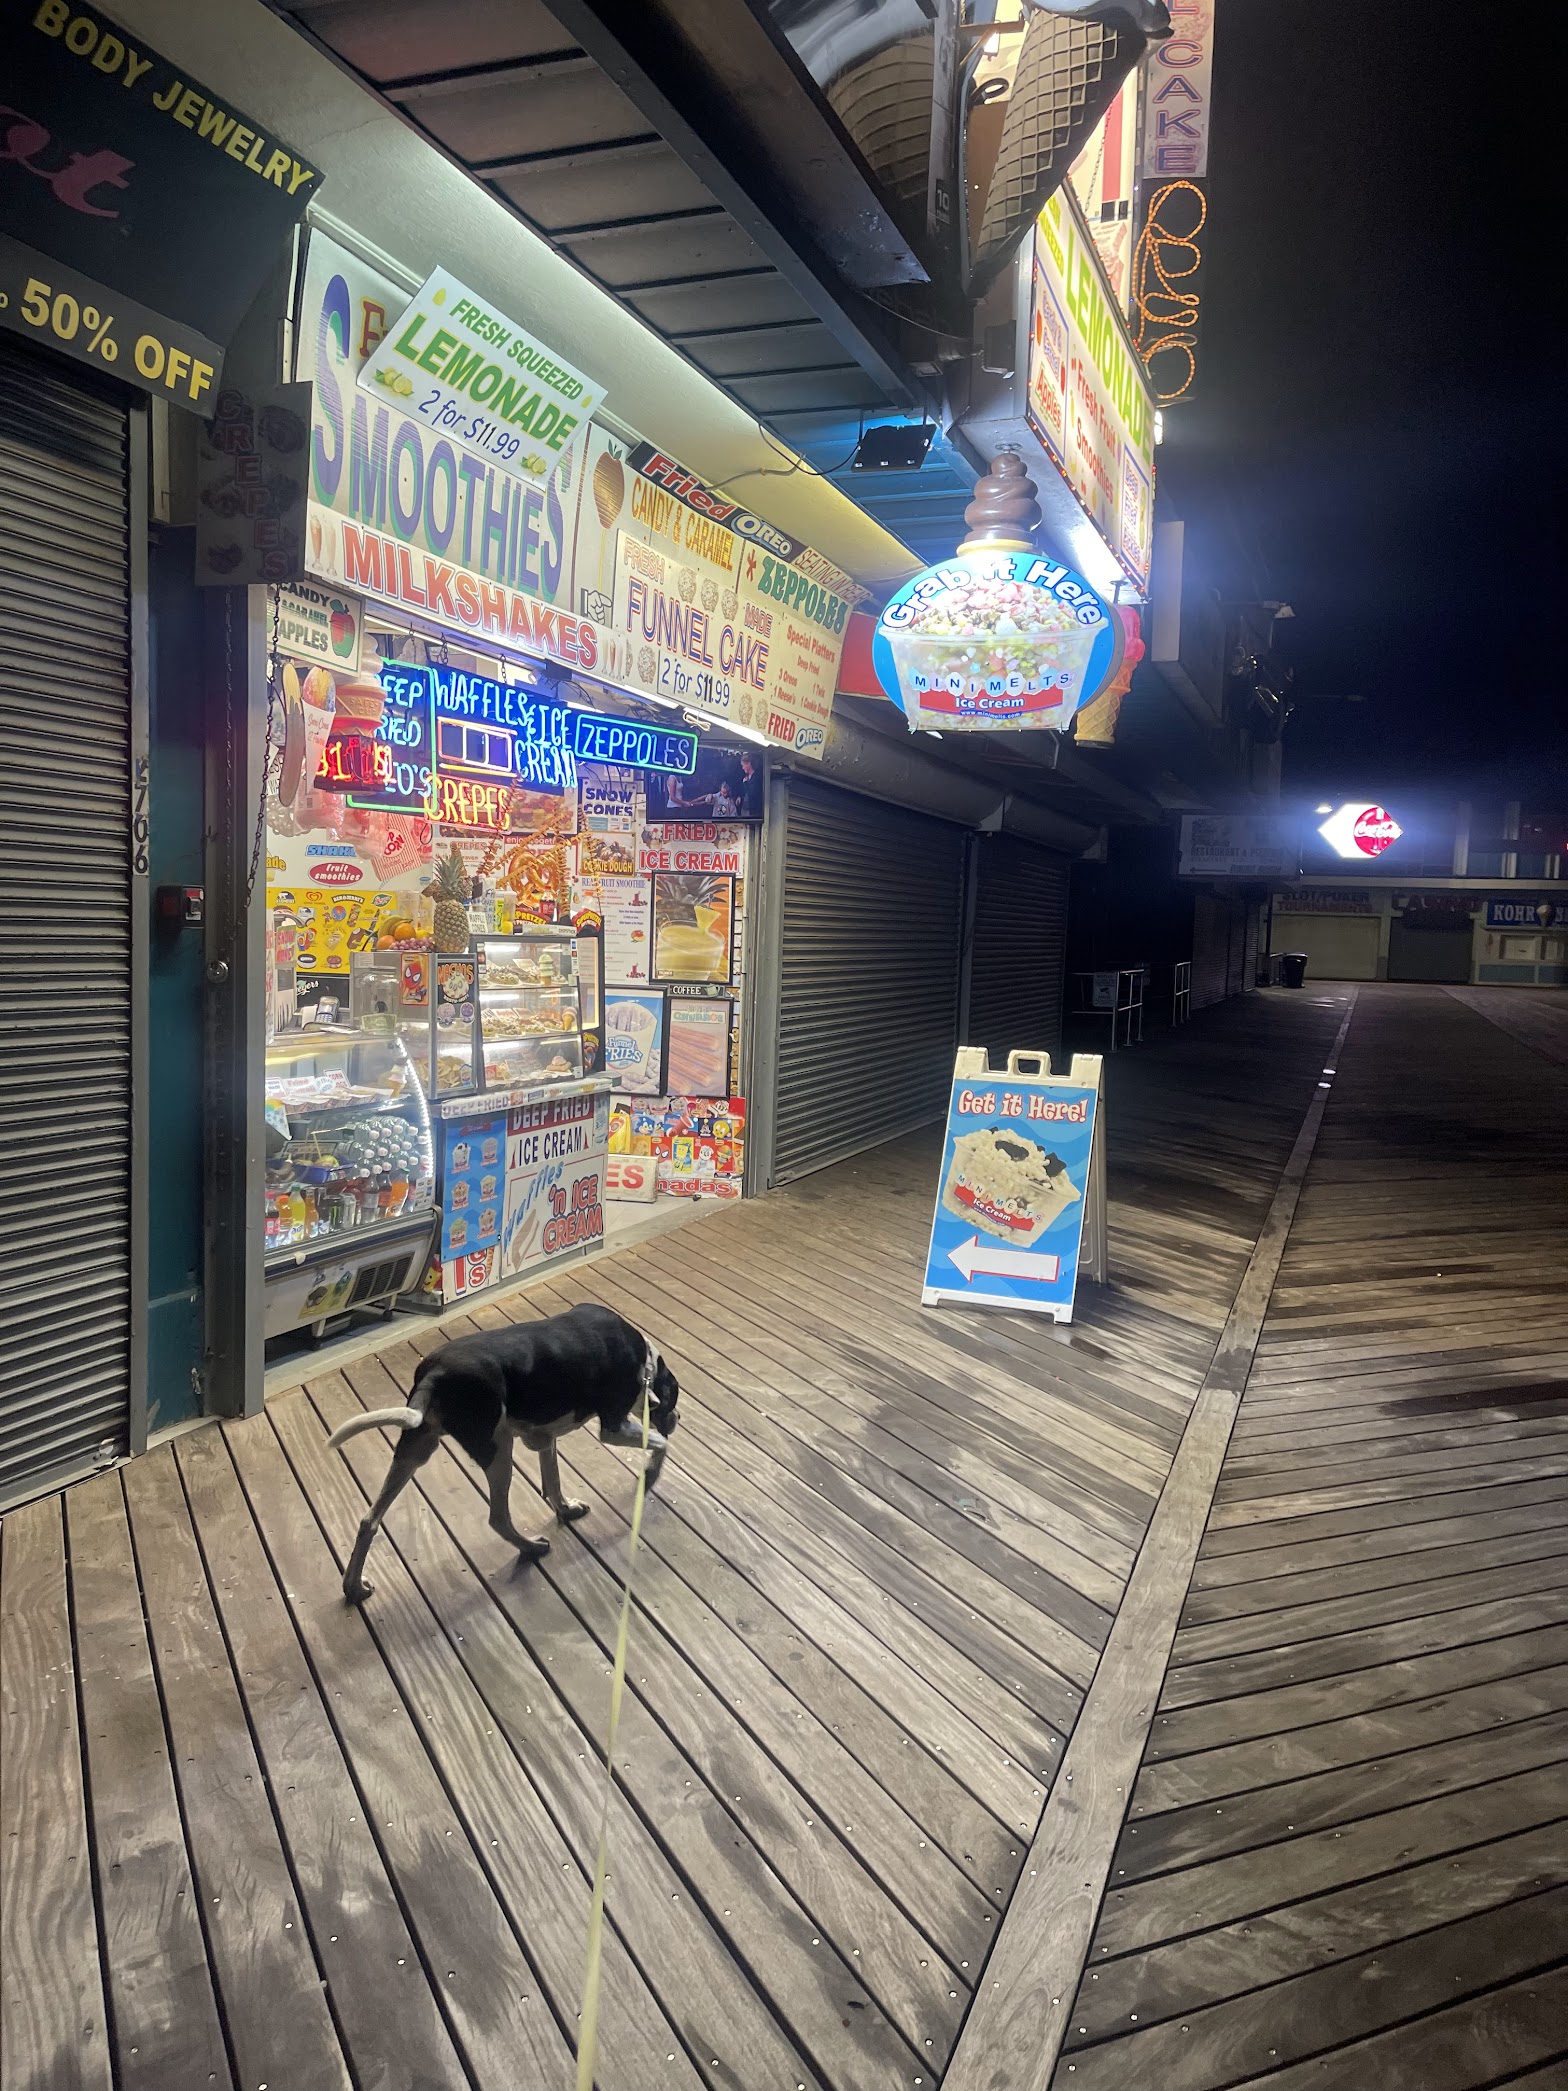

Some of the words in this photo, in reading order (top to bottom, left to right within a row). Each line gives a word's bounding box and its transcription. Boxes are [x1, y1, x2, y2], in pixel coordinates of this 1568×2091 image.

[32, 0, 154, 90] BODY
[152, 80, 315, 196] JEWELRY
[1152, 38, 1205, 174] CAKE
[20, 277, 119, 363] 50%
[134, 334, 214, 401] OFF
[448, 298, 512, 350] FRESH
[507, 338, 585, 401] SQUEEZED
[1066, 223, 1151, 468] LEMONADE
[392, 313, 579, 452] LEMONADE
[1035, 368, 1062, 434] Apples
[418, 389, 441, 415] 2
[431, 400, 467, 426] for
[463, 416, 521, 461] $11.99
[1076, 358, 1098, 426] Fresh
[1099, 403, 1117, 459] Fruit
[310, 274, 574, 606] SMOOTHIES
[1076, 415, 1114, 506] Smoothies
[216, 390, 291, 581] CREPES
[642, 452, 738, 521] Fried
[734, 513, 793, 557] OREO
[631, 476, 674, 539] CANDY
[671, 504, 683, 545] &
[685, 513, 735, 572] CARAMEL
[624, 537, 666, 586] FRESH
[794, 548, 841, 585] SEATING
[280, 581, 331, 608] CANDY
[341, 519, 599, 671] MILKSHAKES
[757, 555, 849, 635] ZEPPOLES
[882, 569, 972, 630] Grab
[981, 557, 1017, 582] it
[1024, 559, 1103, 626] Here
[278, 619, 329, 653] APPLES
[626, 575, 714, 669] FUNNEL
[718, 624, 770, 692] CAKE
[743, 601, 774, 639] MADE
[786, 623, 812, 651] Special
[811, 638, 836, 664] Platters
[661, 658, 672, 686] 2
[673, 662, 693, 695] for
[694, 672, 731, 708] $11.99
[914, 675, 975, 693] MINI
[989, 673, 1070, 692] MELTS
[955, 697, 976, 710] Ice
[978, 697, 1025, 710] Cream
[373, 714, 422, 748] RIED
[432, 667, 528, 727] WAFFLES
[534, 704, 573, 750] ICE
[767, 712, 796, 743] FRIED
[796, 728, 824, 750] OREO
[514, 739, 579, 789] CREAM
[581, 723, 691, 771] ZEPPOLES
[424, 774, 510, 830] CREPES
[583, 803, 634, 817] CONES
[585, 787, 634, 804] SNOW
[663, 823, 718, 842] FRIED
[314, 871, 361, 882] smoothies
[325, 863, 349, 873] fruit
[609, 860, 633, 873] DOUGH
[639, 850, 671, 871] ICE
[674, 851, 739, 872] CREAM
[1493, 903, 1536, 922] KOHR
[672, 985, 702, 995] COFFEE
[608, 1037, 637, 1051] Funnel
[513, 1100, 550, 1131] DEEP
[553, 1094, 591, 1123] FRIED
[957, 1088, 997, 1116] Get
[1000, 1091, 1024, 1118] it
[1026, 1093, 1089, 1123] Here!
[518, 1135, 539, 1167] ICE
[543, 1125, 583, 1160] CREAM
[571, 1173, 599, 1213] ICE
[605, 1163, 645, 1190] ES
[658, 1178, 732, 1195] nadas
[957, 1174, 990, 1200] MINI
[995, 1198, 1042, 1221] MELTS
[503, 1160, 565, 1255] Waffles
[542, 1202, 604, 1256] CREAM
[972, 1198, 985, 1209] Ice
[984, 1204, 1012, 1222] Cream
